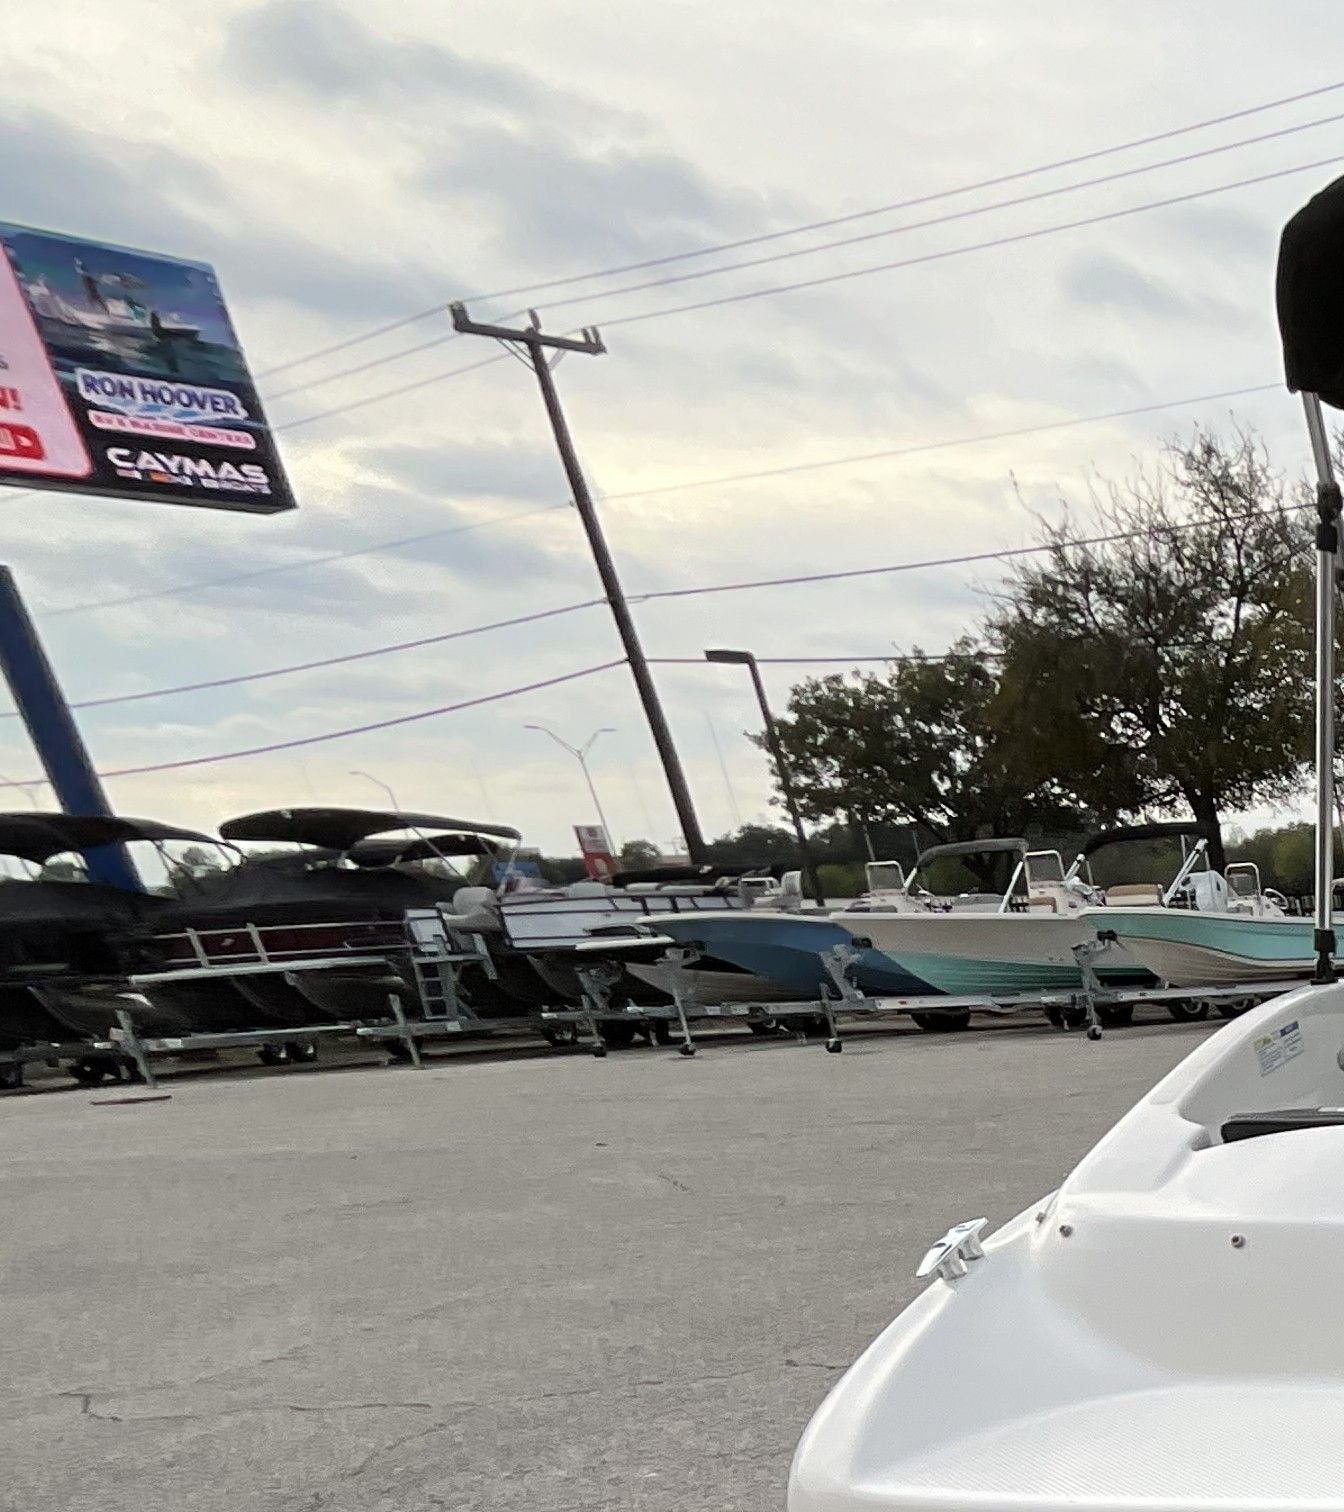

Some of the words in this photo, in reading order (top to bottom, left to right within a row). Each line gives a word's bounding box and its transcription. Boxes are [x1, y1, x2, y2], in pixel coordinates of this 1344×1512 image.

[82, 373, 133, 397] RON
[140, 382, 237, 414] HOOVER
[107, 447, 270, 484] CAYMAS
